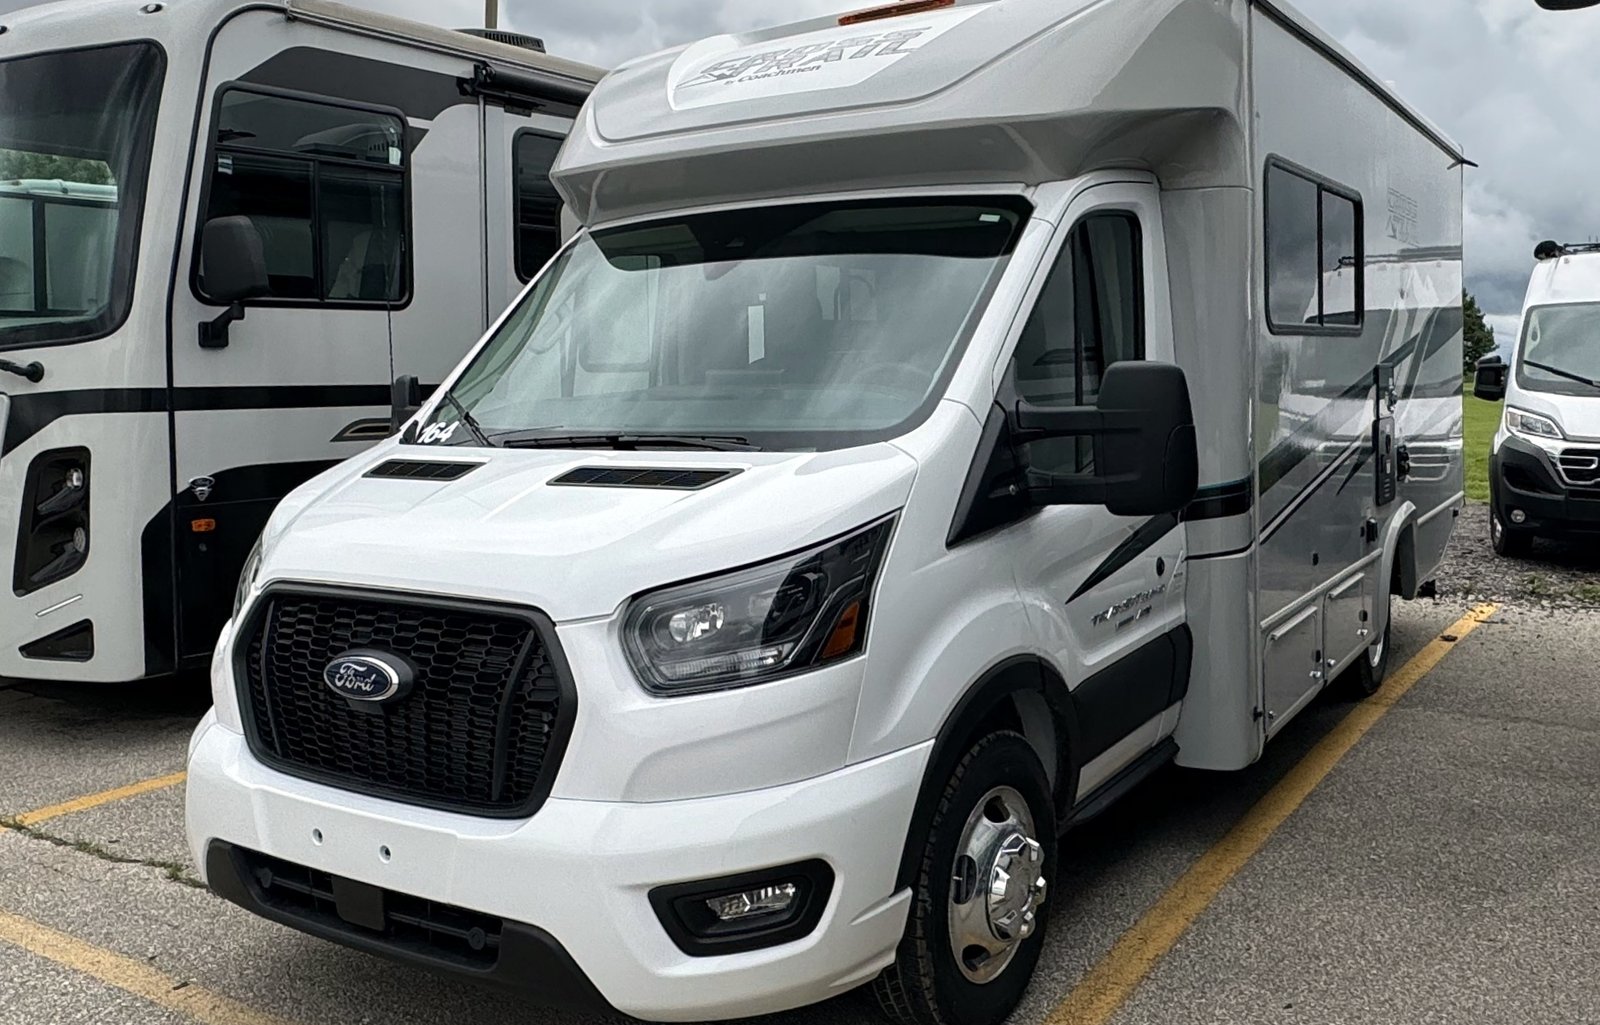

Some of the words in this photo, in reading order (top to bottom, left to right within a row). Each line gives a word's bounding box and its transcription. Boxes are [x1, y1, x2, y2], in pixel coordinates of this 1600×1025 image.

[737, 64, 822, 83] Coachmen
[416, 420, 460, 444] 164
[334, 662, 377, 692] Ford
